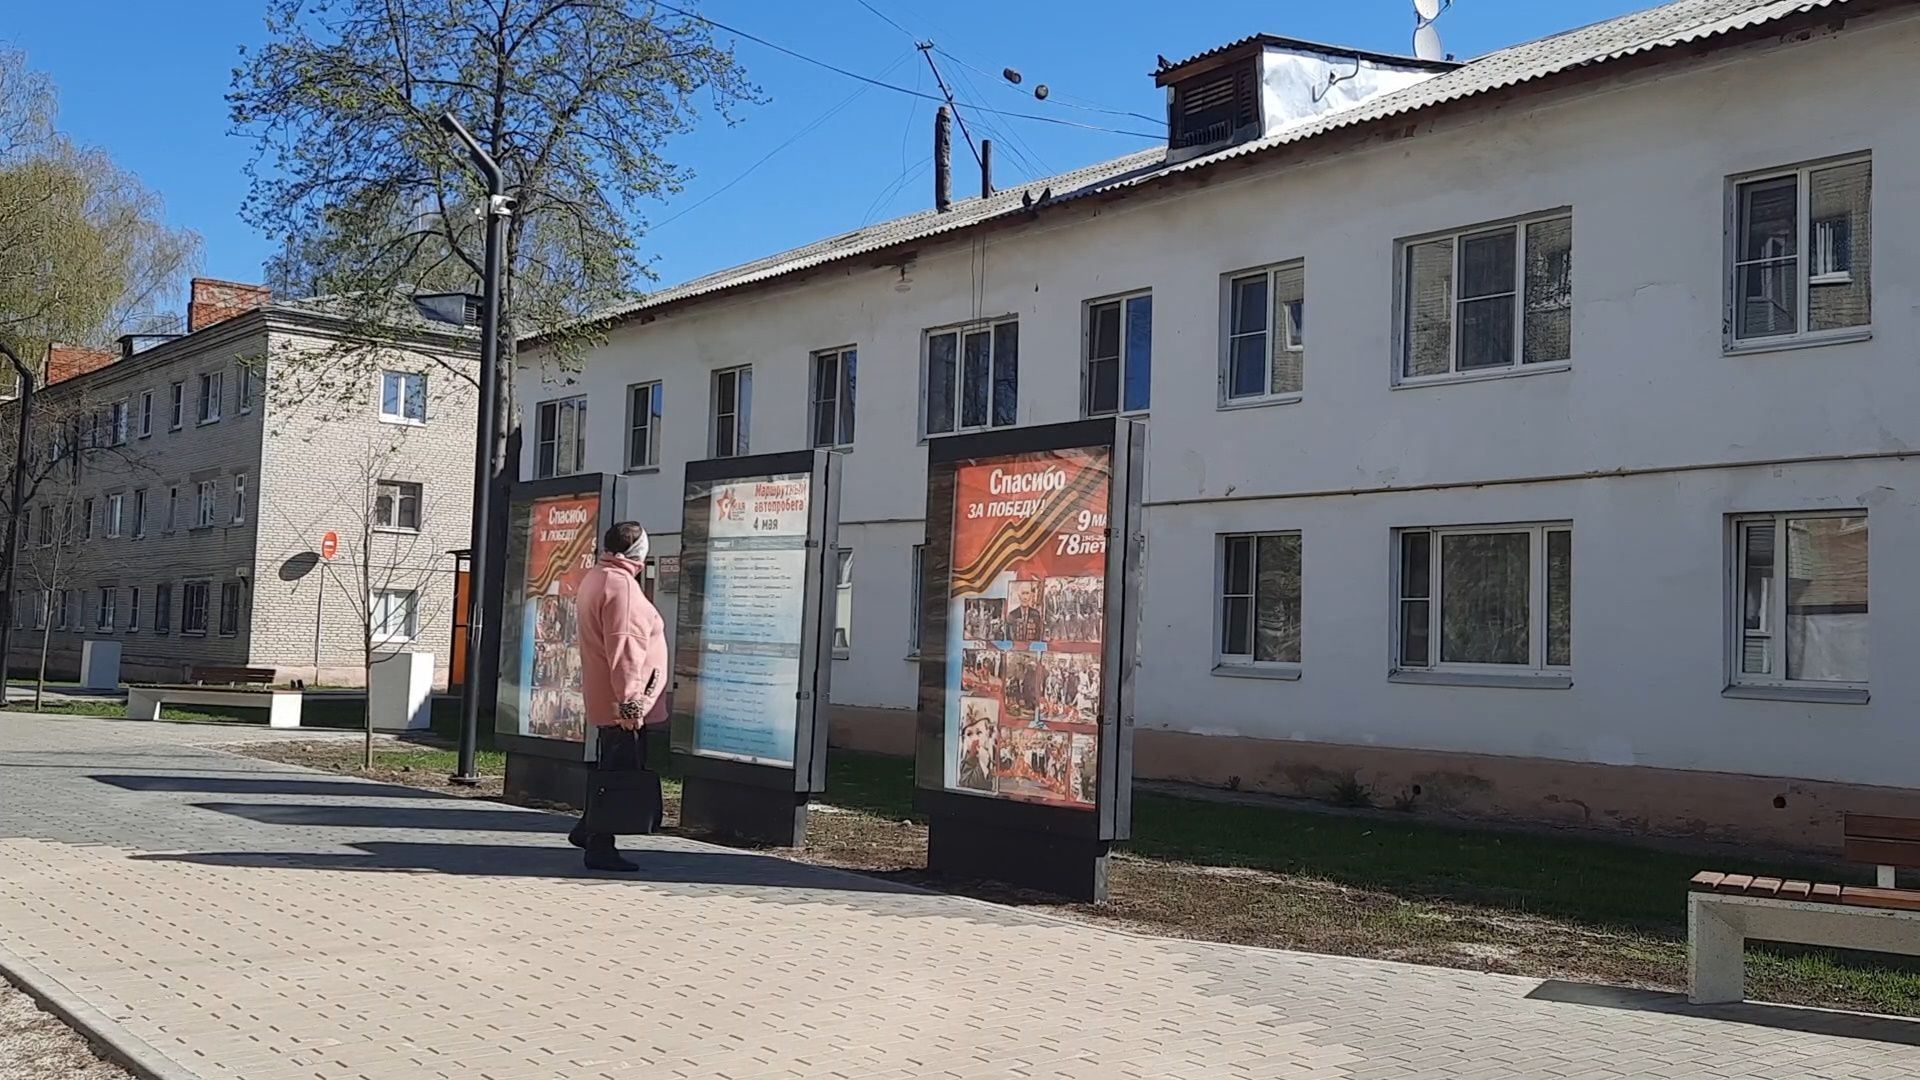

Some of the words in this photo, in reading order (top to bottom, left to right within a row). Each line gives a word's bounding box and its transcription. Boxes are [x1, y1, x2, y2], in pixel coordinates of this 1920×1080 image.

[990, 464, 1066, 495] Спасибо
[755, 483, 806, 498] Маршрутный
[549, 505, 587, 525] Спасибо
[755, 498, 804, 514] автопробега
[968, 503, 984, 519] ЗА
[986, 499, 1046, 519] ПОБЕДУ!
[753, 517, 759, 530] 4
[761, 519, 779, 530] мая
[1077, 509, 1091, 531] 9
[1056, 533, 1080, 556] 78
[1079, 540, 1106, 554] лет
